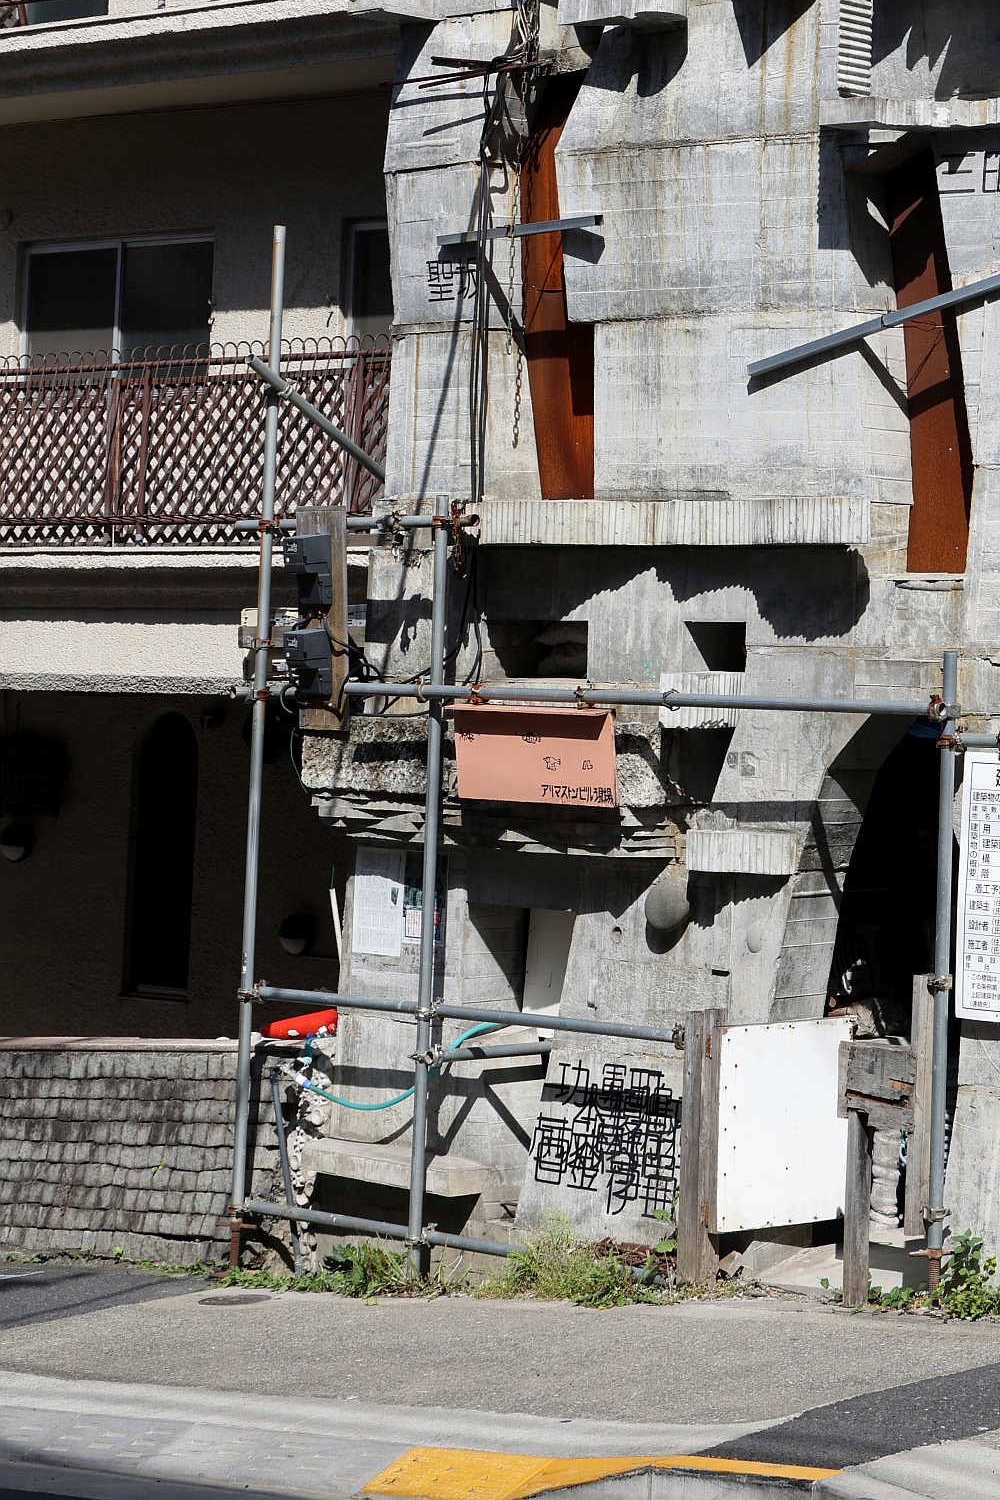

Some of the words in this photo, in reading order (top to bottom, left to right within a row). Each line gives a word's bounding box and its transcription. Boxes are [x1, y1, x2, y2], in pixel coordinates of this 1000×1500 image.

[541, 784, 613, 804] アリマストンビル現場
